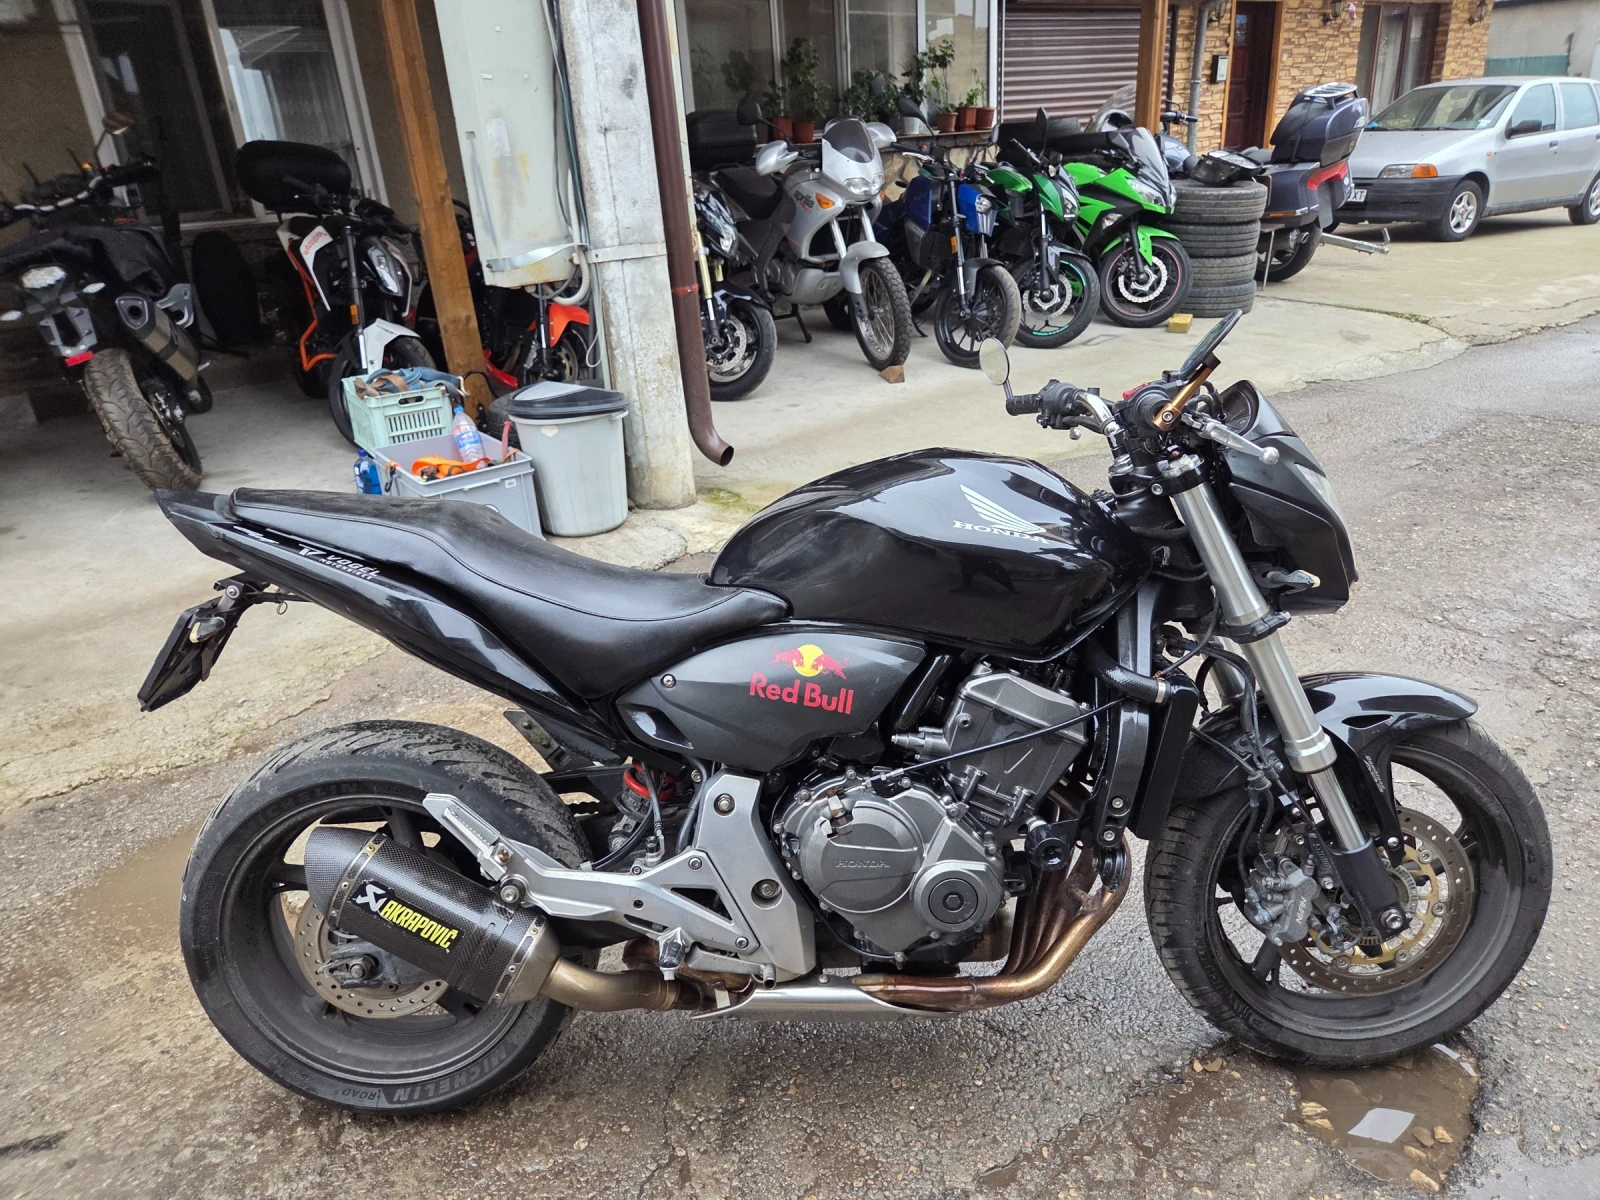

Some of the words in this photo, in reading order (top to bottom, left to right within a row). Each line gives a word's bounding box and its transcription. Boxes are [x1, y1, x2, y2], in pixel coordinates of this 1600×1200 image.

[952, 520, 1051, 545] HONDA
[326, 554, 381, 577] VOGEL
[749, 671, 801, 704] Red
[803, 682, 854, 715] Bull
[835, 860, 891, 869] HONDA
[392, 1044, 507, 1102] MICHELIN
[342, 1087, 377, 1101] ROAD
